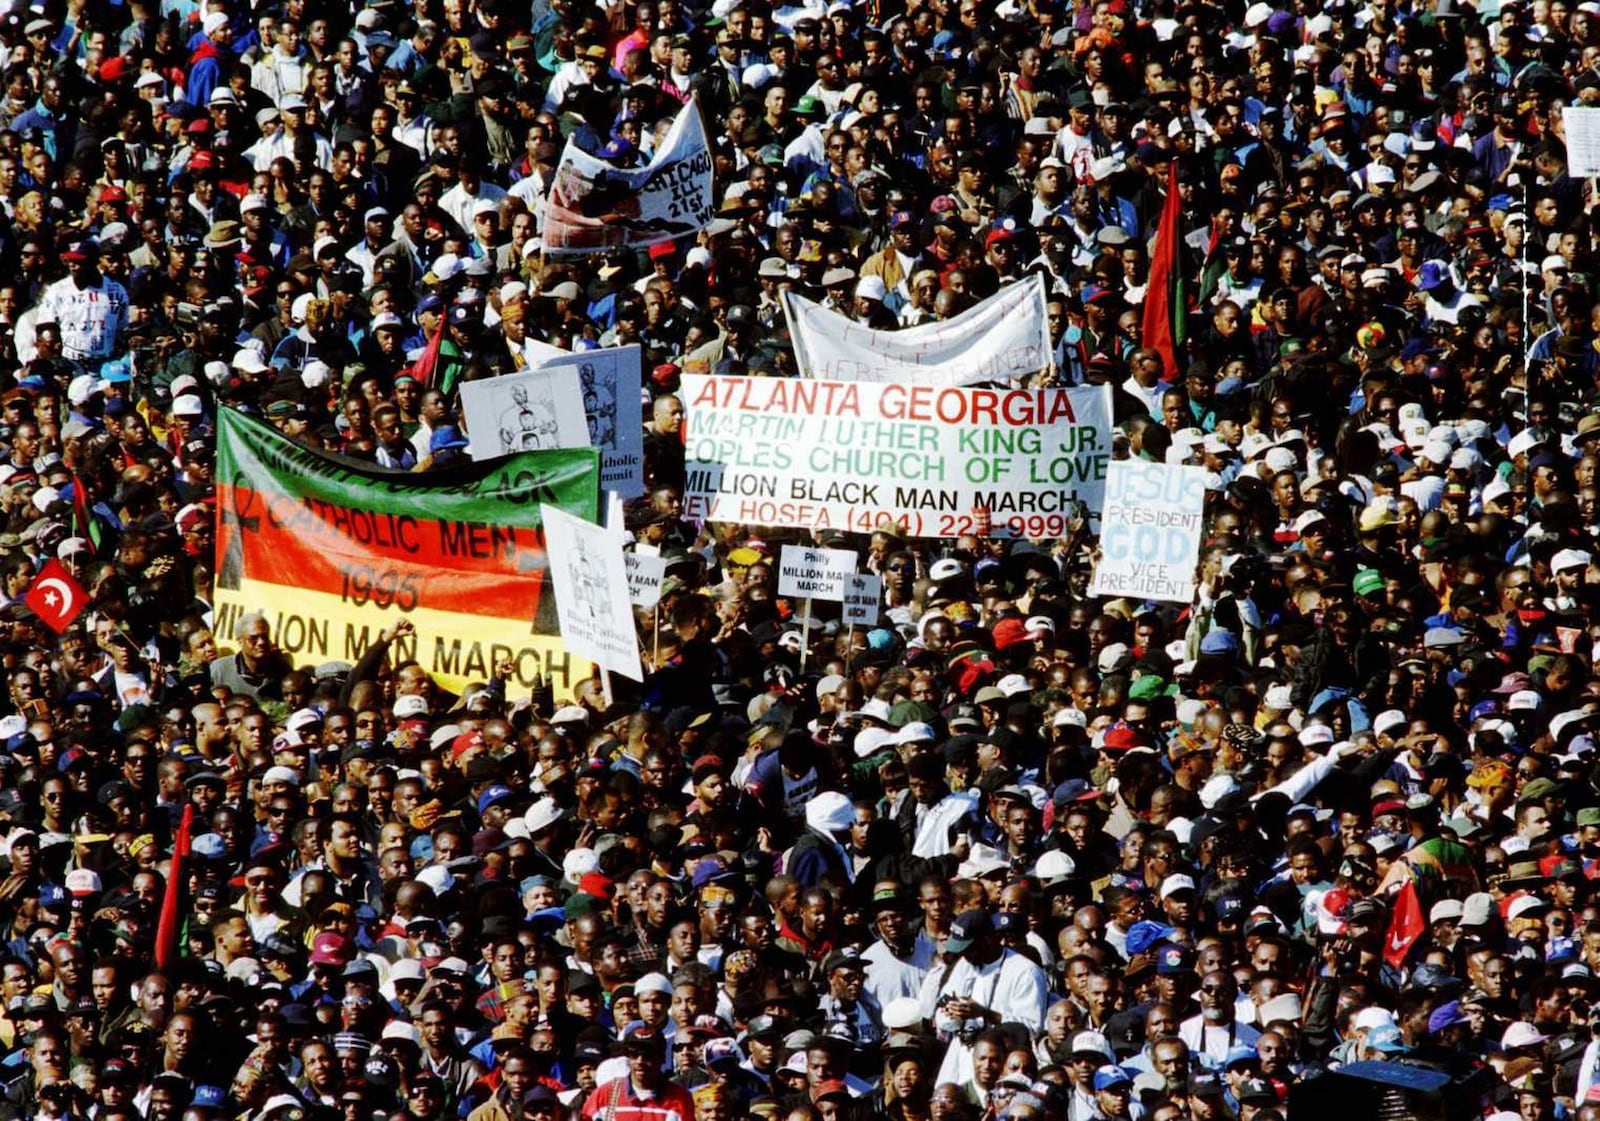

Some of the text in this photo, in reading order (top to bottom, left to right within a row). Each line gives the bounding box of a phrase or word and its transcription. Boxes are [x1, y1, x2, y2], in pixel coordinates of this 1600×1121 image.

[693, 377, 1077, 426] ATLANTA GEORGIA
[690, 411, 1104, 455] MARTIN LUTHER KING JR.
[809, 446, 945, 481] CHURCH
[965, 456, 1012, 484] OF
[1030, 453, 1109, 484] LOVE
[684, 469, 1077, 513] MILLION BLACK MAN MARCH
[1106, 463, 1204, 513] JESUS
[739, 500, 831, 527] HOSEA
[1108, 505, 1200, 532] PRESIDENT
[267, 497, 518, 559] CATHOLIC MEN
[804, 552, 830, 565] Philly
[1131, 562, 1168, 579] VICE
[634, 574, 658, 586] MAN
[782, 566, 824, 579] MILLION
[1099, 573, 1186, 597] PRESIDENT
[340, 565, 419, 612] 1995
[797, 581, 833, 592] MARCH
